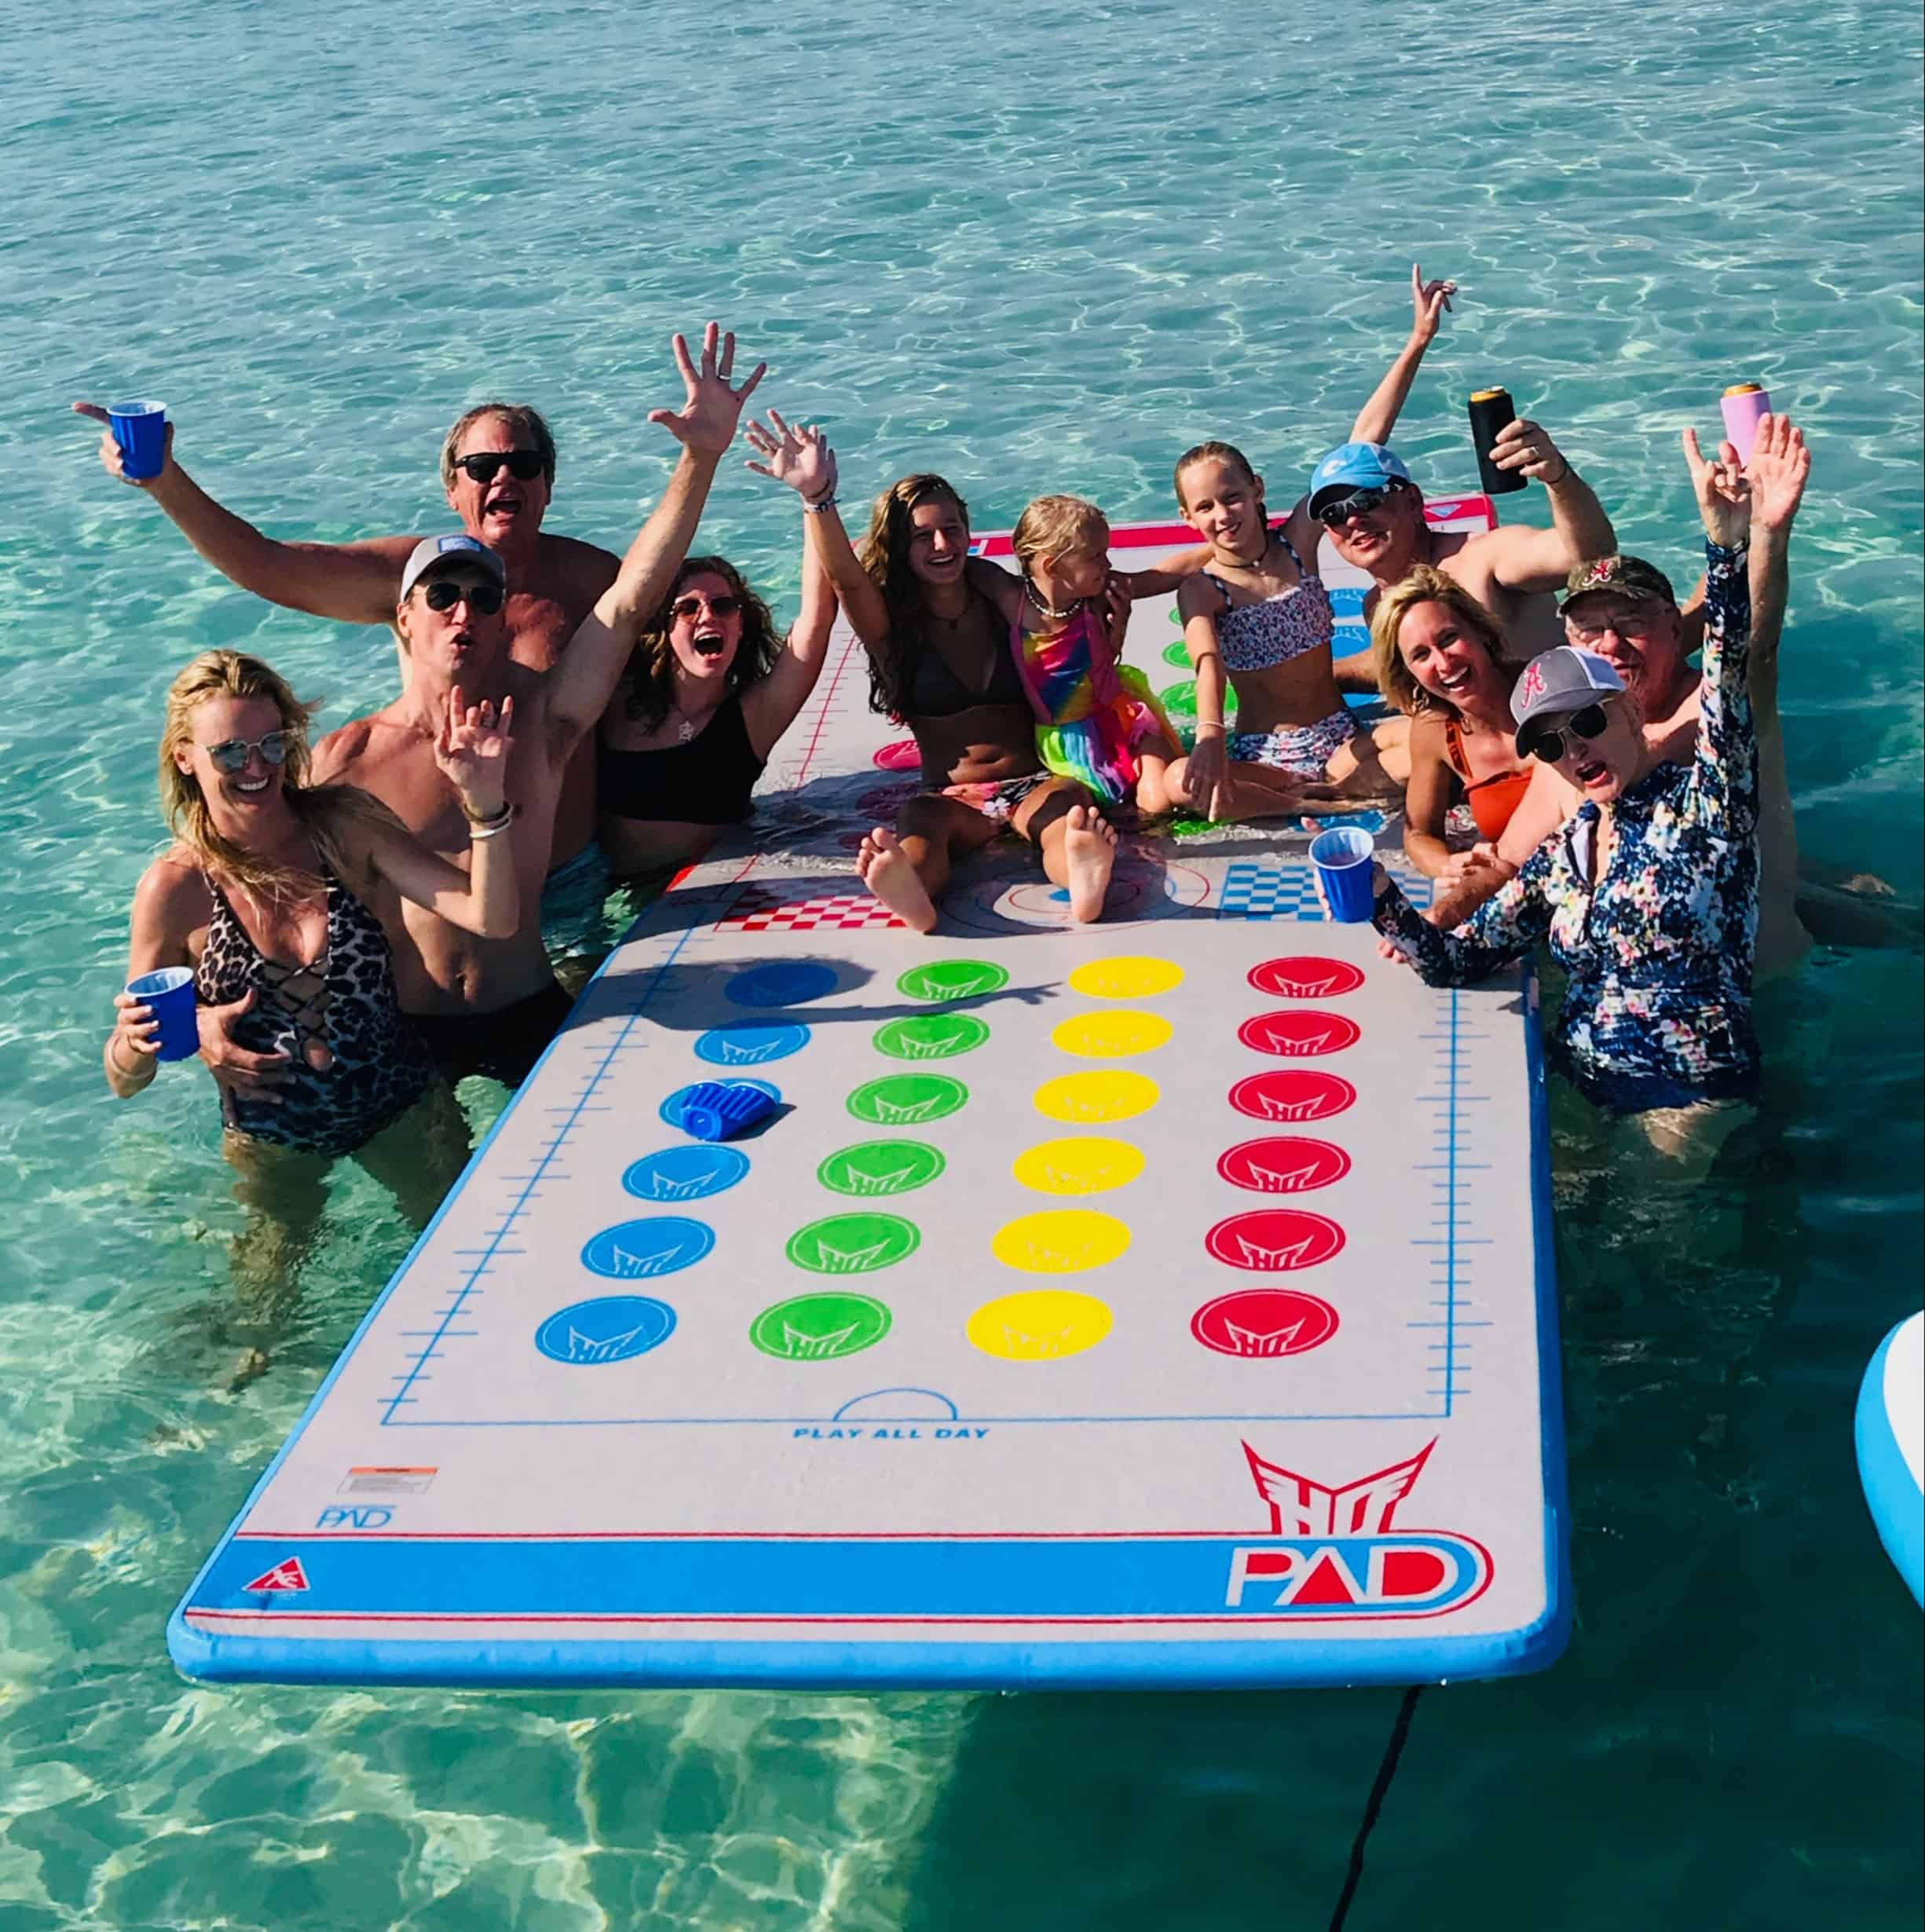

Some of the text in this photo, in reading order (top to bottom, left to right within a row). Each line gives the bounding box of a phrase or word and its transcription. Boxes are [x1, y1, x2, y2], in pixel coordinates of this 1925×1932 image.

[793, 1428, 990, 1439] PLAY ALL DAY
[315, 1508, 392, 1528] PAD
[1224, 1546, 1460, 1607] PAD
